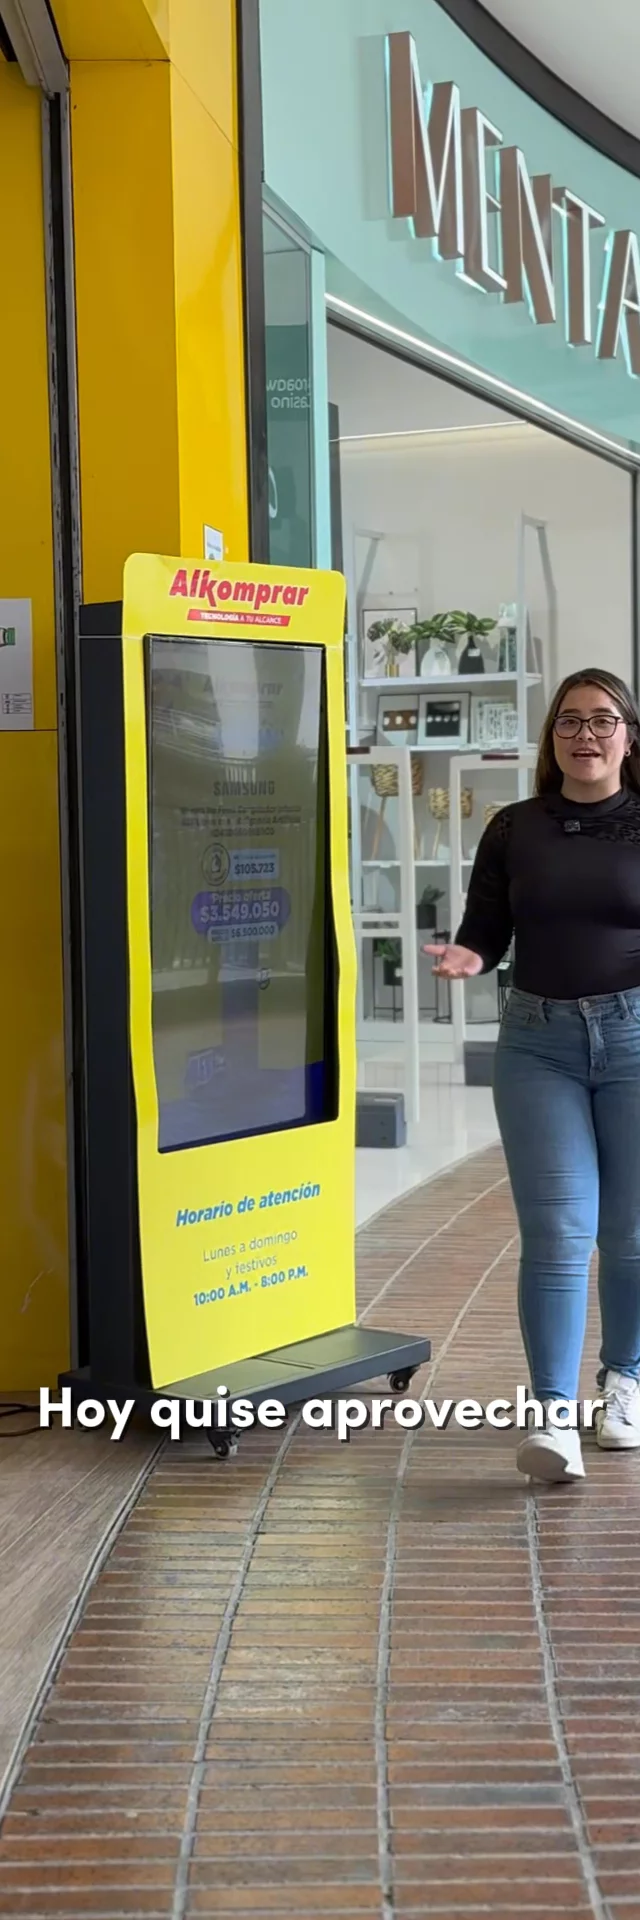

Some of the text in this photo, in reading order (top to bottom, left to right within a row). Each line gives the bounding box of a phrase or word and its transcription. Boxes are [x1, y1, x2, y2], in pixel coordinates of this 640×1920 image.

[169, 569, 309, 610] Alkomprar
[200, 612, 239, 621] TECNOLOGÍA
[255, 616, 282, 625] ALCANCE
[213, 780, 275, 796] SAMSUNG
[200, 900, 280, 923] $3.549.050
[176, 1181, 320, 1227] Horario de atención
[203, 1230, 298, 1262] Lunes a domingo
[226, 1254, 277, 1280] y festivos
[193, 1287, 225, 1306] 10:00
[228, 1280, 251, 1297] A.M.
[260, 1271, 285, 1288] 8:00
[288, 1265, 308, 1281] P.M.
